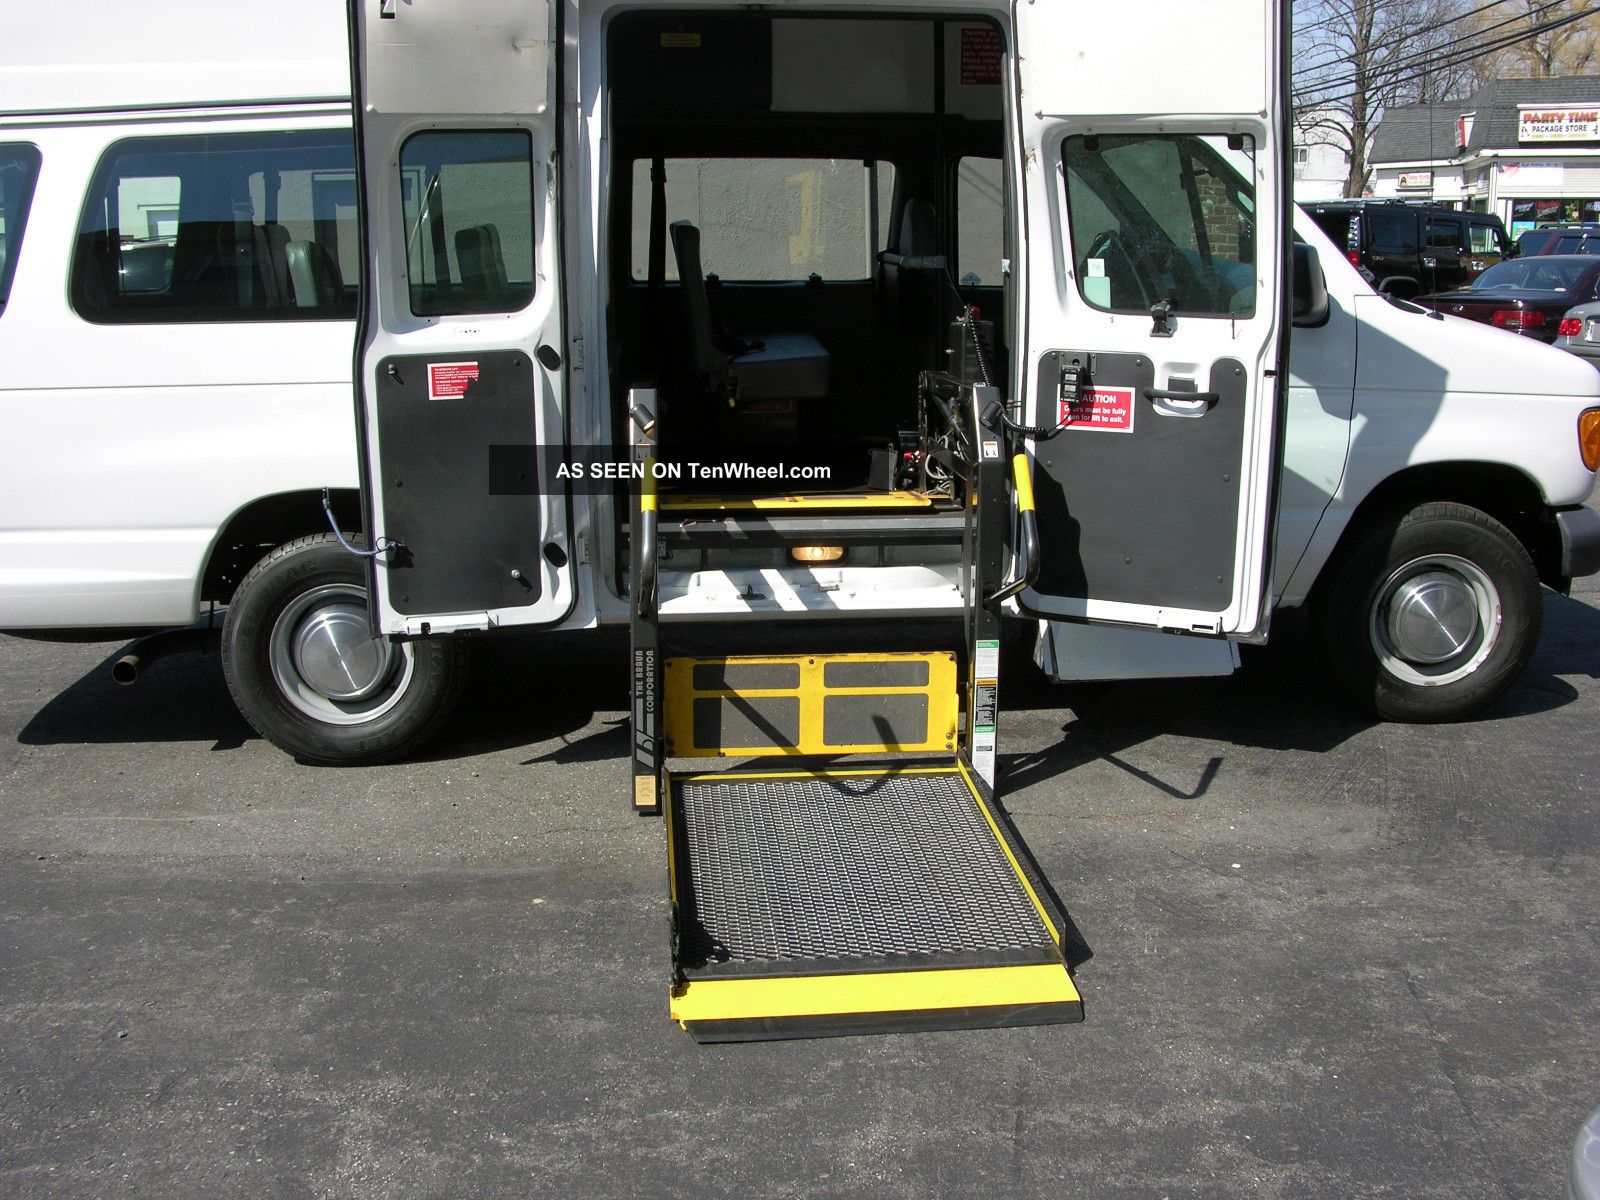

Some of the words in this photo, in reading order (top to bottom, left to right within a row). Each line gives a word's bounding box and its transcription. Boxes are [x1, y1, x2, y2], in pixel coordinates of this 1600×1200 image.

[1523, 112, 1566, 124] PARTY
[1568, 111, 1598, 123] TIME
[1565, 124, 1587, 132] STORE
[1081, 394, 1117, 404] AUTION
[1064, 405, 1084, 413] Dors
[1112, 407, 1127, 416] fully
[635, 650, 644, 678] BRAUN
[646, 650, 654, 712] CORPORATION
[635, 680, 644, 696] THE
